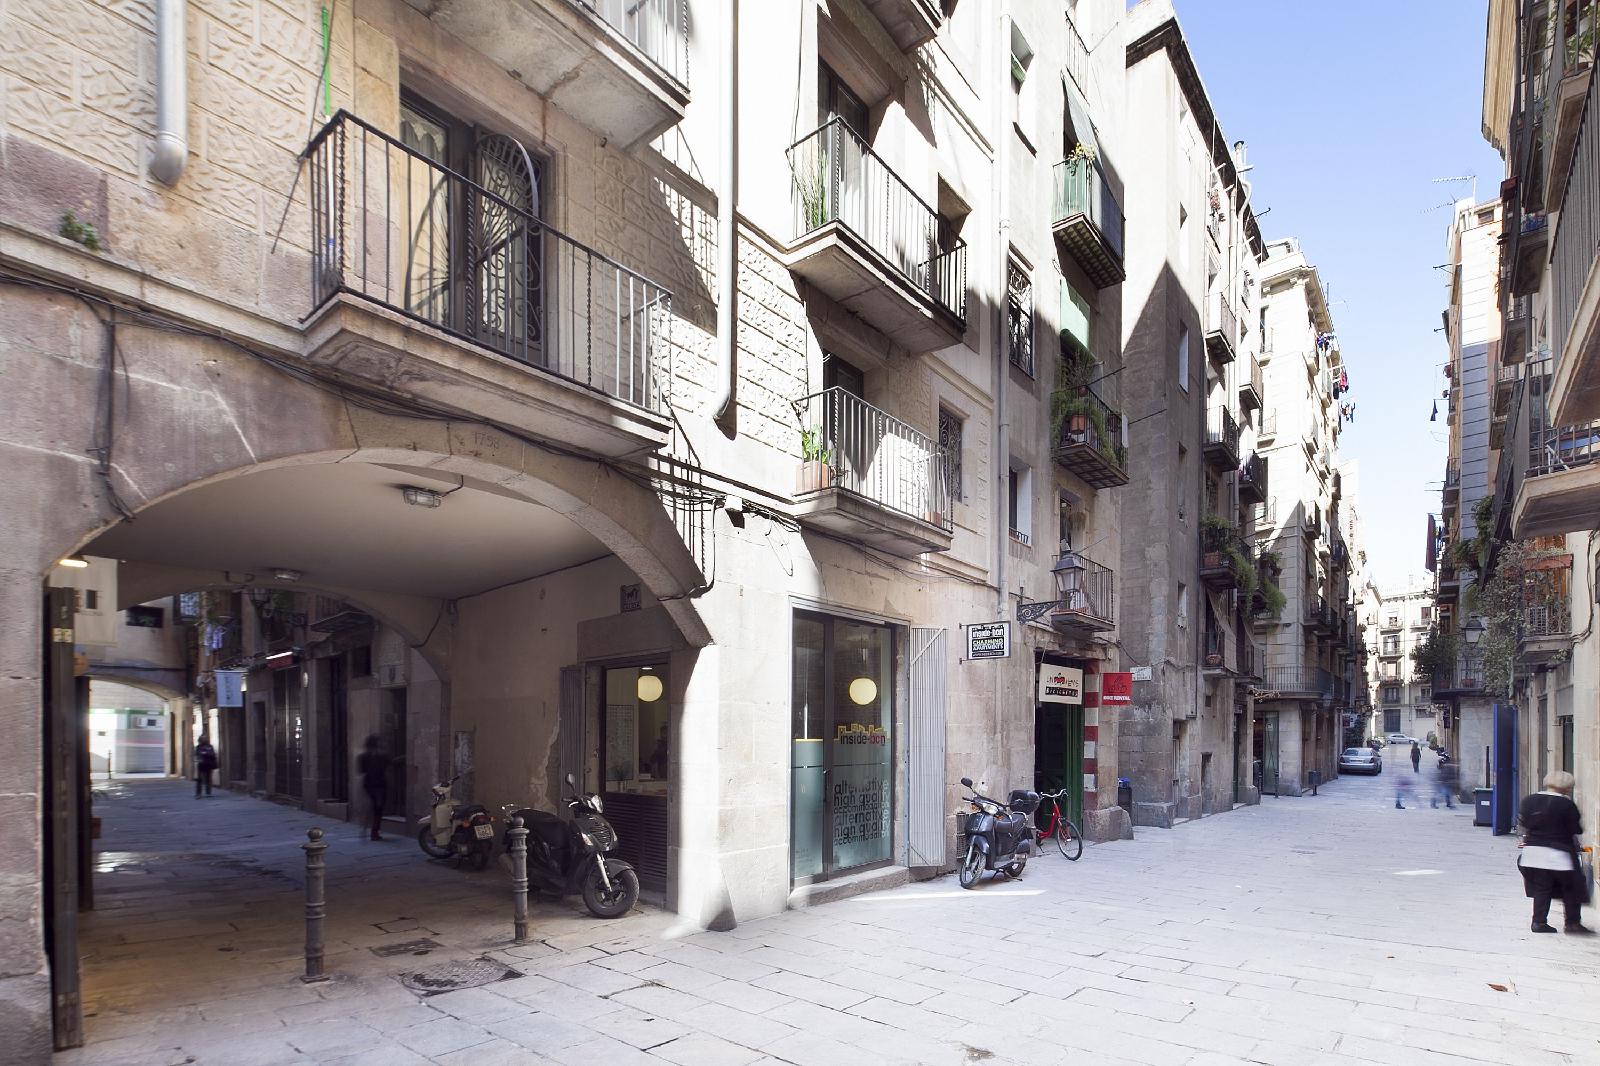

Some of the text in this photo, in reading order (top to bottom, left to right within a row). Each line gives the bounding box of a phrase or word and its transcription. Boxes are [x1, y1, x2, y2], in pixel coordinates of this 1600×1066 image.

[840, 733, 886, 746] inside-bcn
[833, 790, 856, 807] high
[833, 823, 856, 839] high
